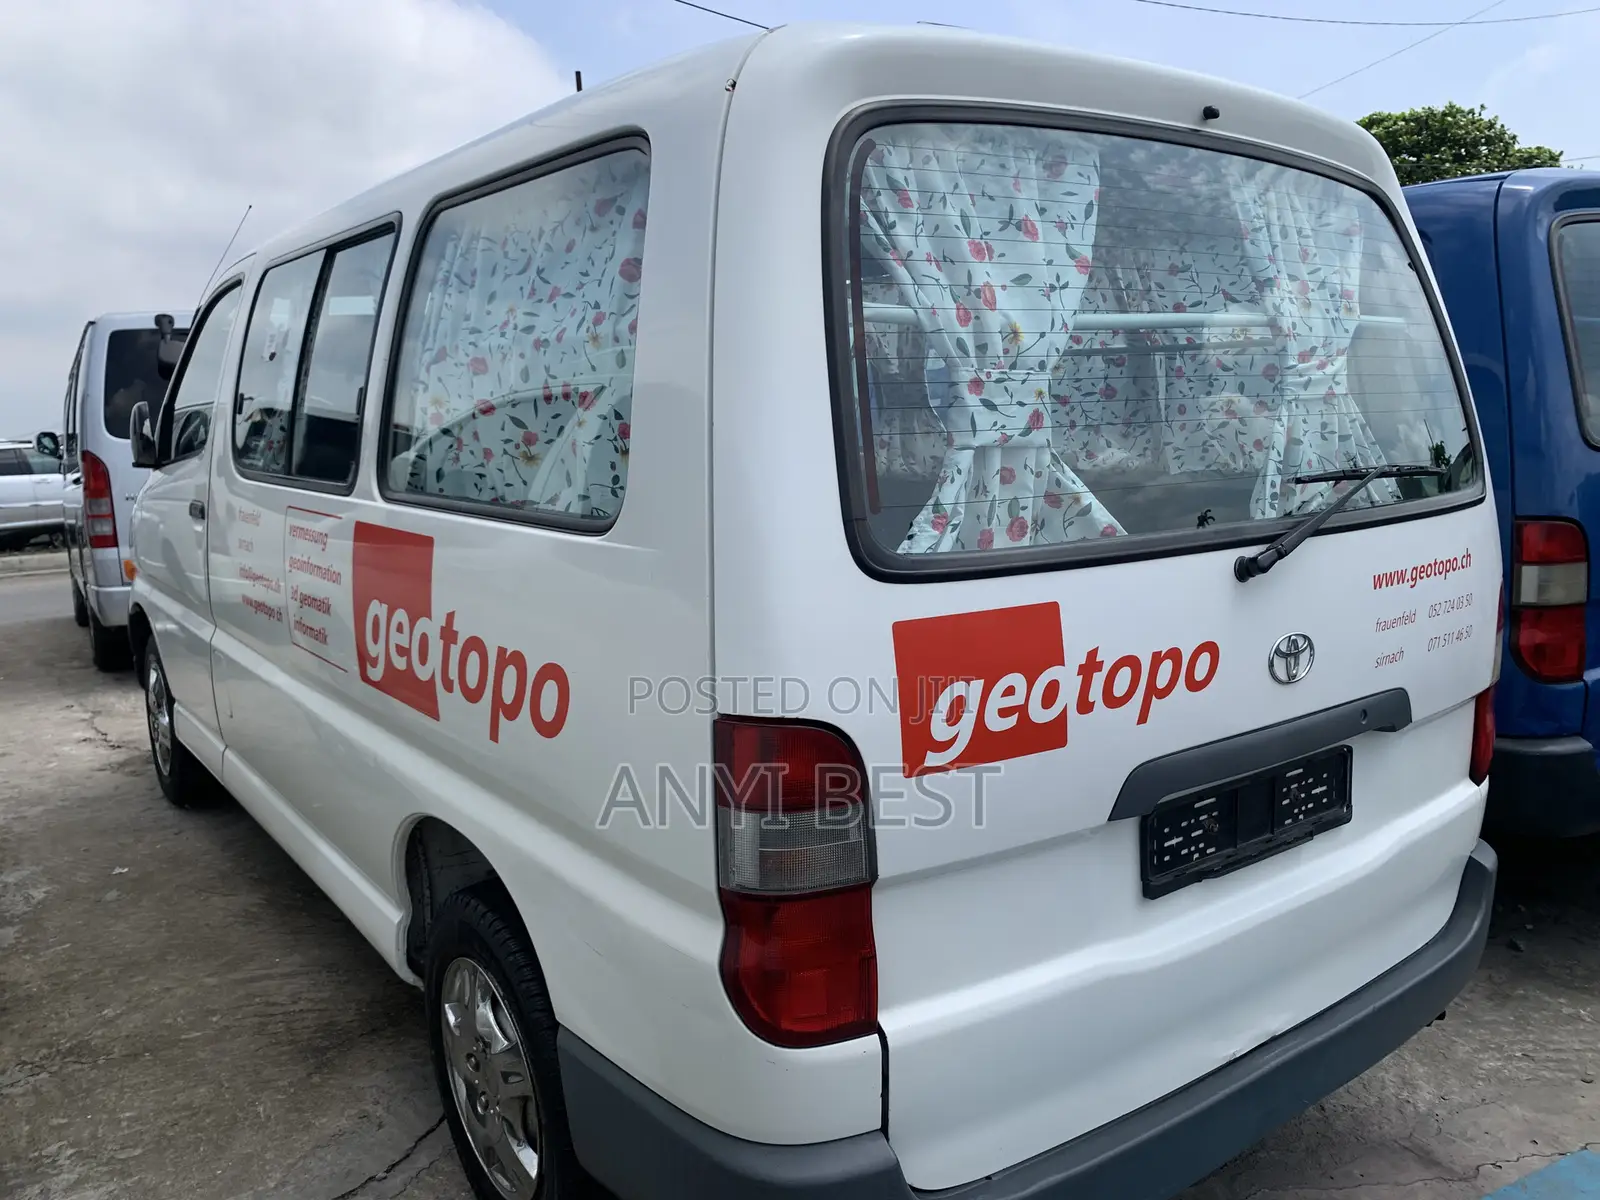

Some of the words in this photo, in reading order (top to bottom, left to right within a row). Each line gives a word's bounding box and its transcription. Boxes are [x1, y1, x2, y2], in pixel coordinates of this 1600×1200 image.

[289, 524, 328, 552] vermessung
[288, 554, 341, 585] geoinformation
[1373, 548, 1472, 590] www.geotopo.ch
[299, 592, 332, 616] geomatik
[1375, 609, 1417, 632] frauenfeld
[1428, 602, 1441, 618] 052
[1443, 598, 1455, 614] 724
[293, 613, 329, 645] informatik
[1375, 647, 1404, 668] sirnach
[1427, 635, 1441, 652] 071
[1442, 631, 1455, 648] 511
[1456, 627, 1464, 642] 46
[365, 599, 570, 744] geotopo
[924, 640, 1220, 767] geotopo
